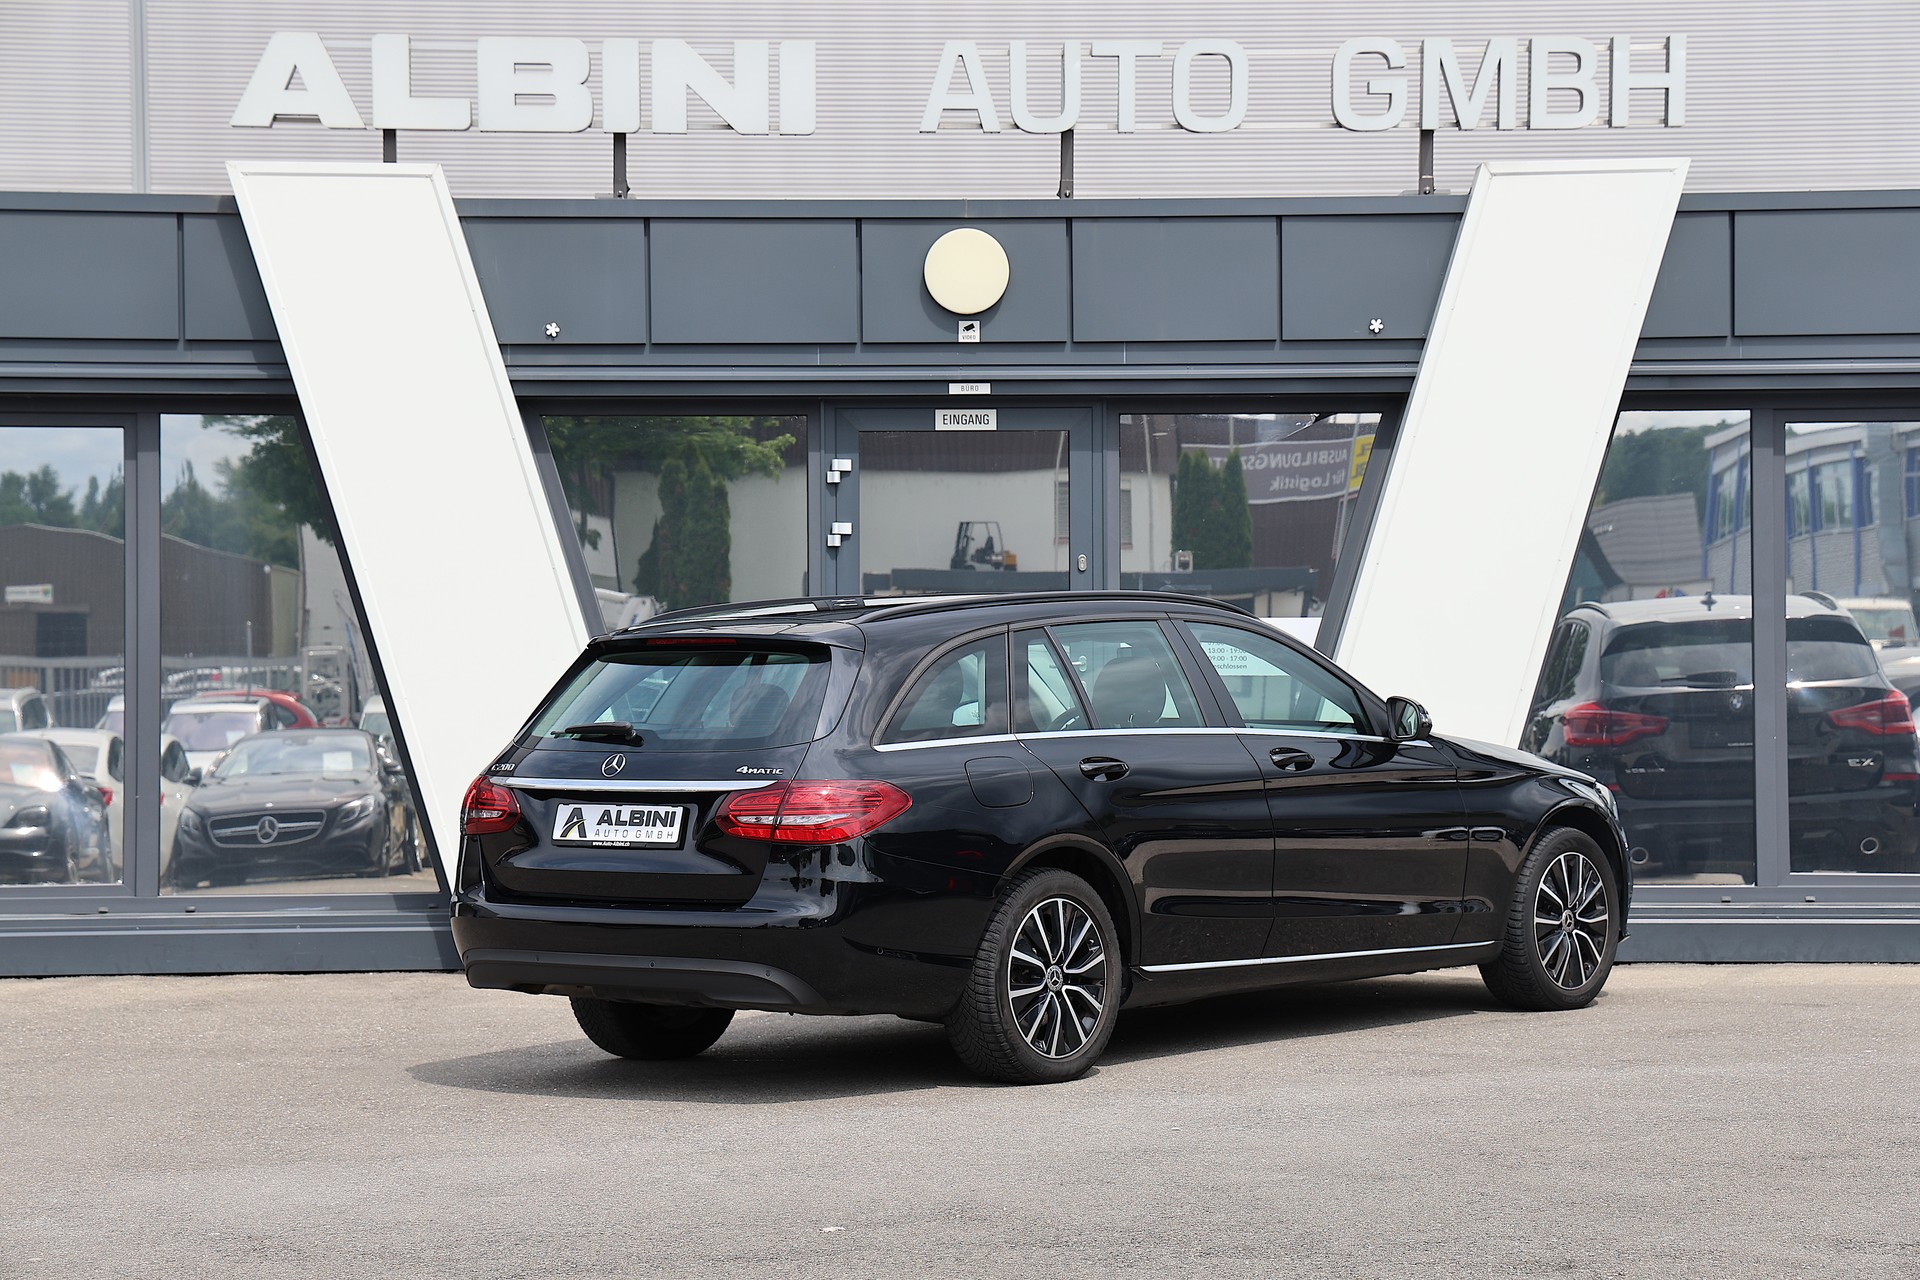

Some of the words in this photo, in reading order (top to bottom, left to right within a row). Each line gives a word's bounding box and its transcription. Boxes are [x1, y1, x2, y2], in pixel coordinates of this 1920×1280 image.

[229, 31, 817, 136] ALBINI
[919, 38, 1249, 134] AUTO
[1330, 34, 1687, 132] GMBH
[960, 384, 979, 392] BÜRO
[942, 413, 990, 425] EINGANG
[596, 809, 677, 828] ALBINI
[594, 829, 629, 839] AUTO
[635, 830, 673, 839] GMBH
